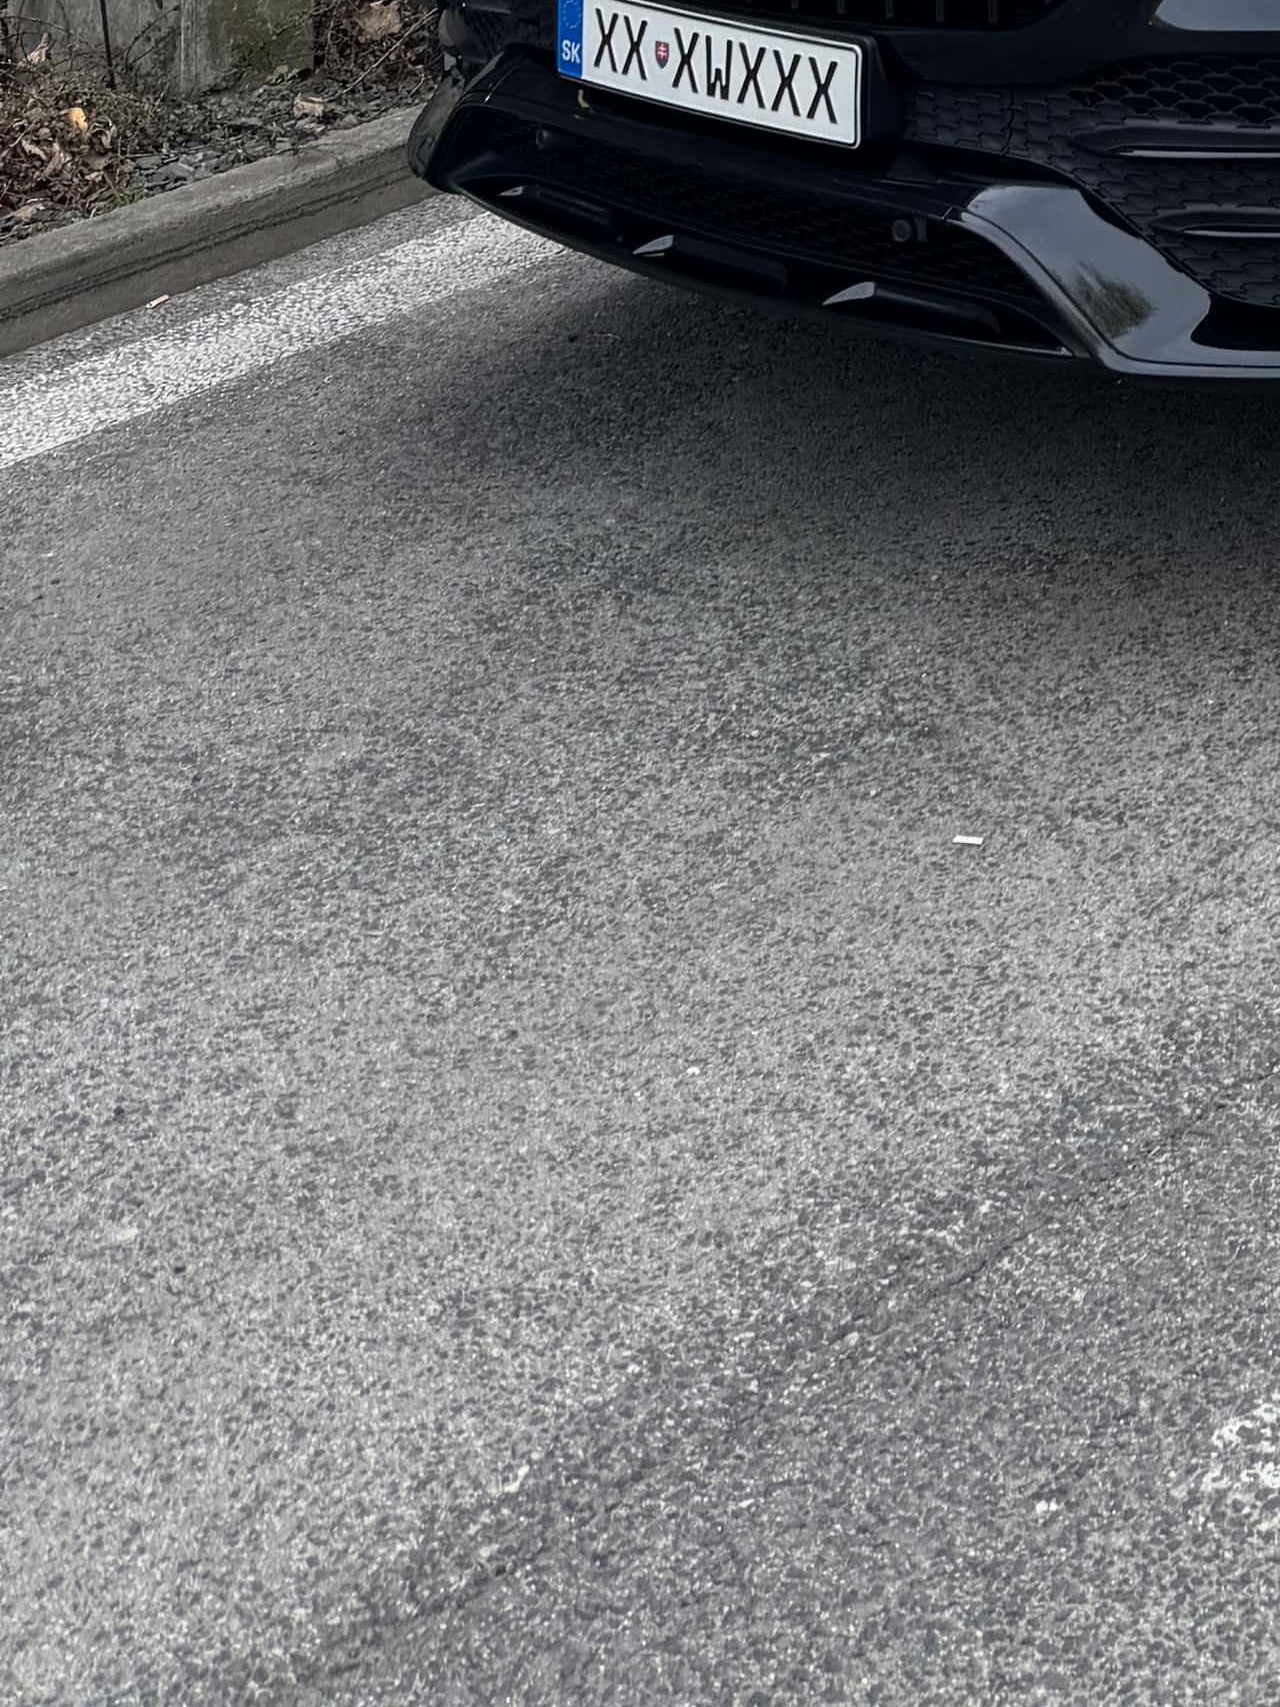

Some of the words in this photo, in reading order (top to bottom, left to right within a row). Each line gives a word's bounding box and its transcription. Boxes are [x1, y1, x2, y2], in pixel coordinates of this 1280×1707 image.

[562, 39, 581, 64] SK
[594, 7, 648, 81] XX
[671, 27, 838, 125] XWXXX
